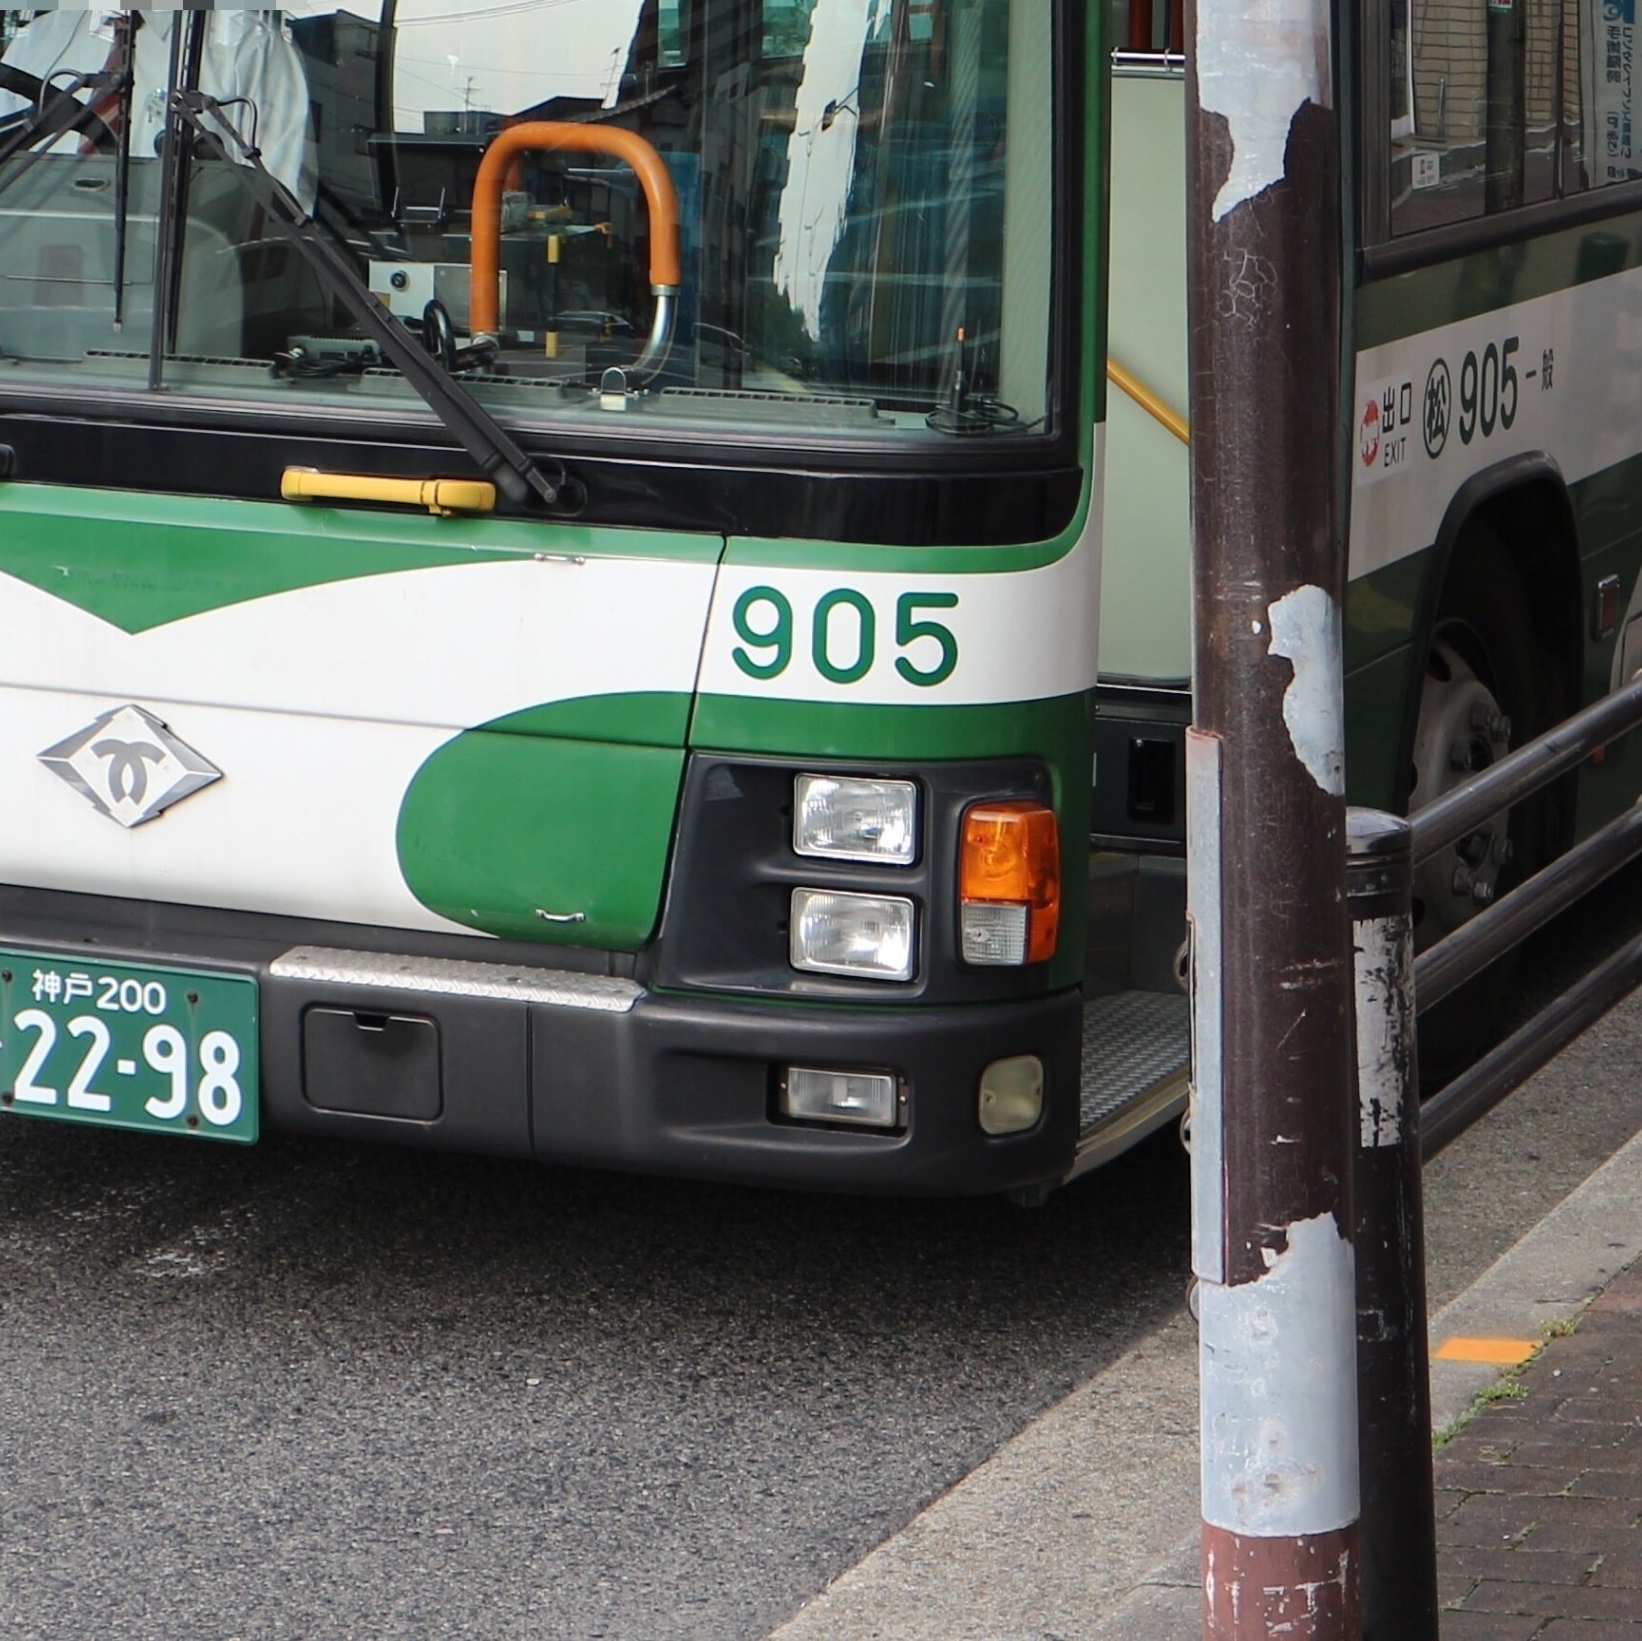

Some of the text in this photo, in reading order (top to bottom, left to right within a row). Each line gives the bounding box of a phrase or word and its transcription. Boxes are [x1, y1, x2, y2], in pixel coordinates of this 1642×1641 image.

[1382, 382, 1412, 434] 出口
[1459, 335, 1519, 446] 905
[1384, 437, 1406, 468] EXIT
[730, 585, 959, 688] 905
[31, 969, 167, 1015] 神戸200
[13, 1008, 242, 1126] 22-98
